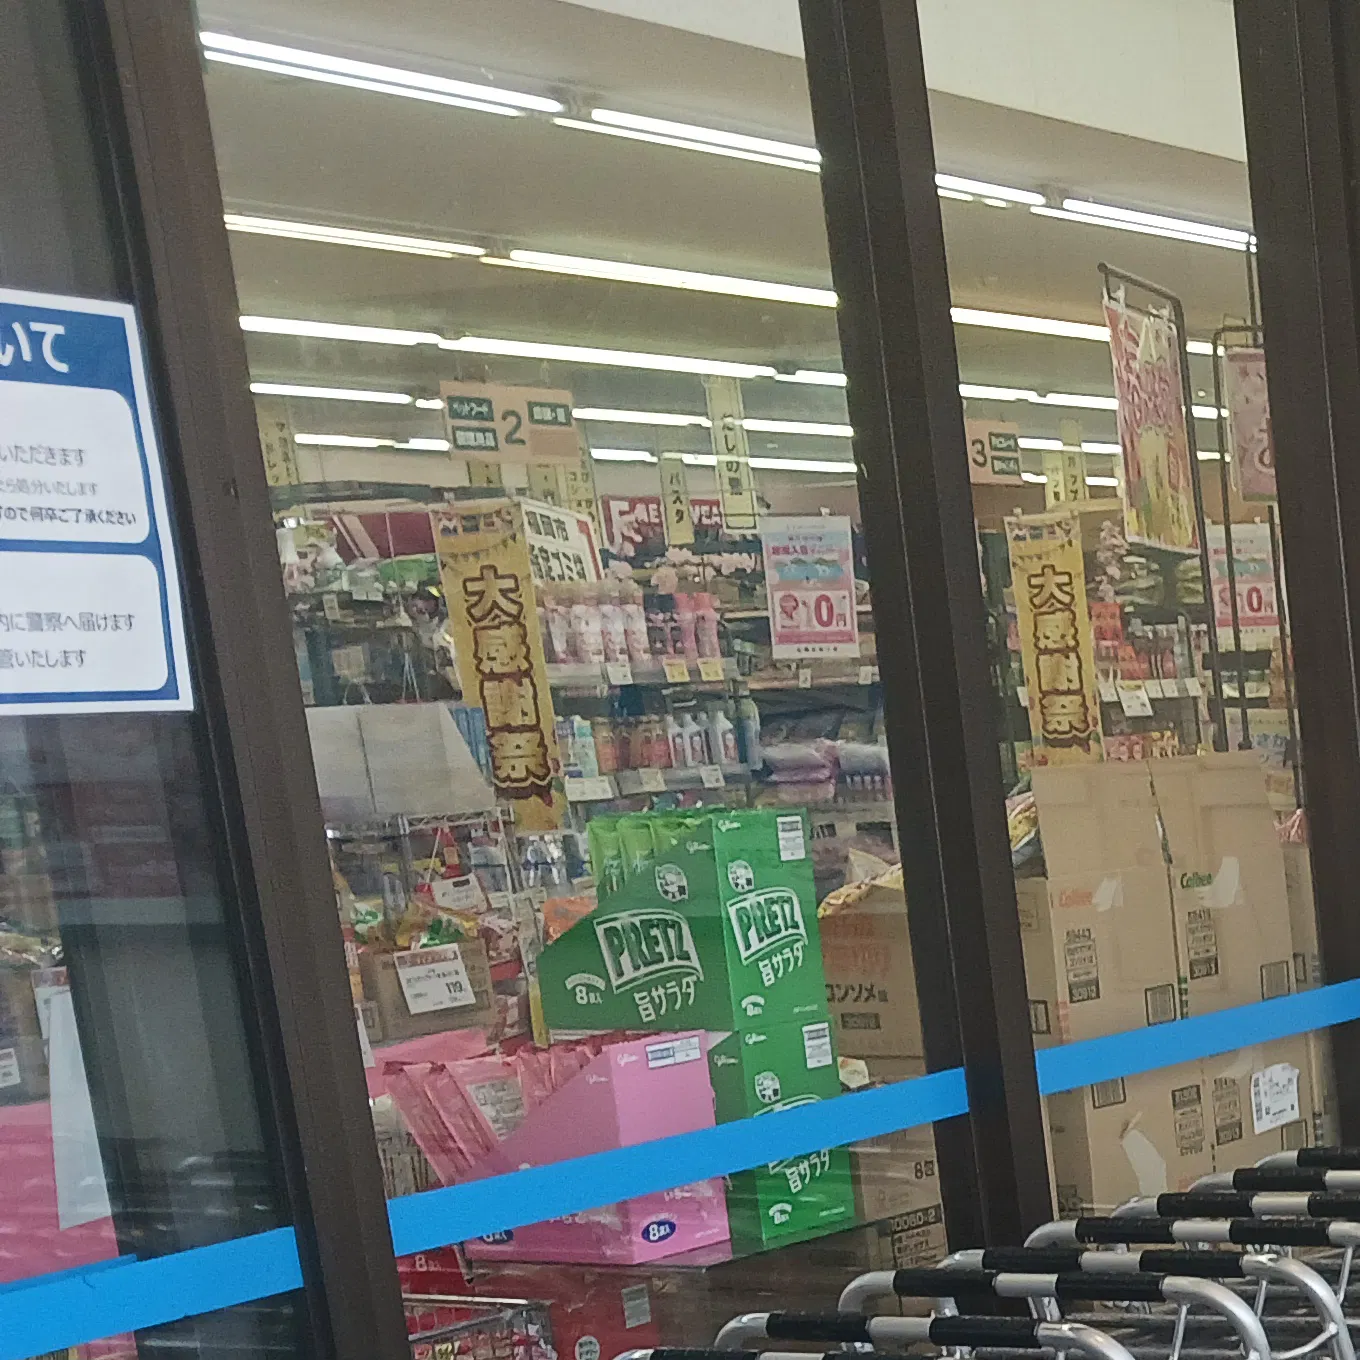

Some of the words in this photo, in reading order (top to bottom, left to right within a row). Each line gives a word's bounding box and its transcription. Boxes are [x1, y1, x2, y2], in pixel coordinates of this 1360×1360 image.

[501, 409, 526, 446] 2
[972, 438, 987, 467] 3
[736, 896, 800, 951] PRETZ
[604, 918, 691, 977] PRETZ
[825, 981, 888, 1003] コンソメ
